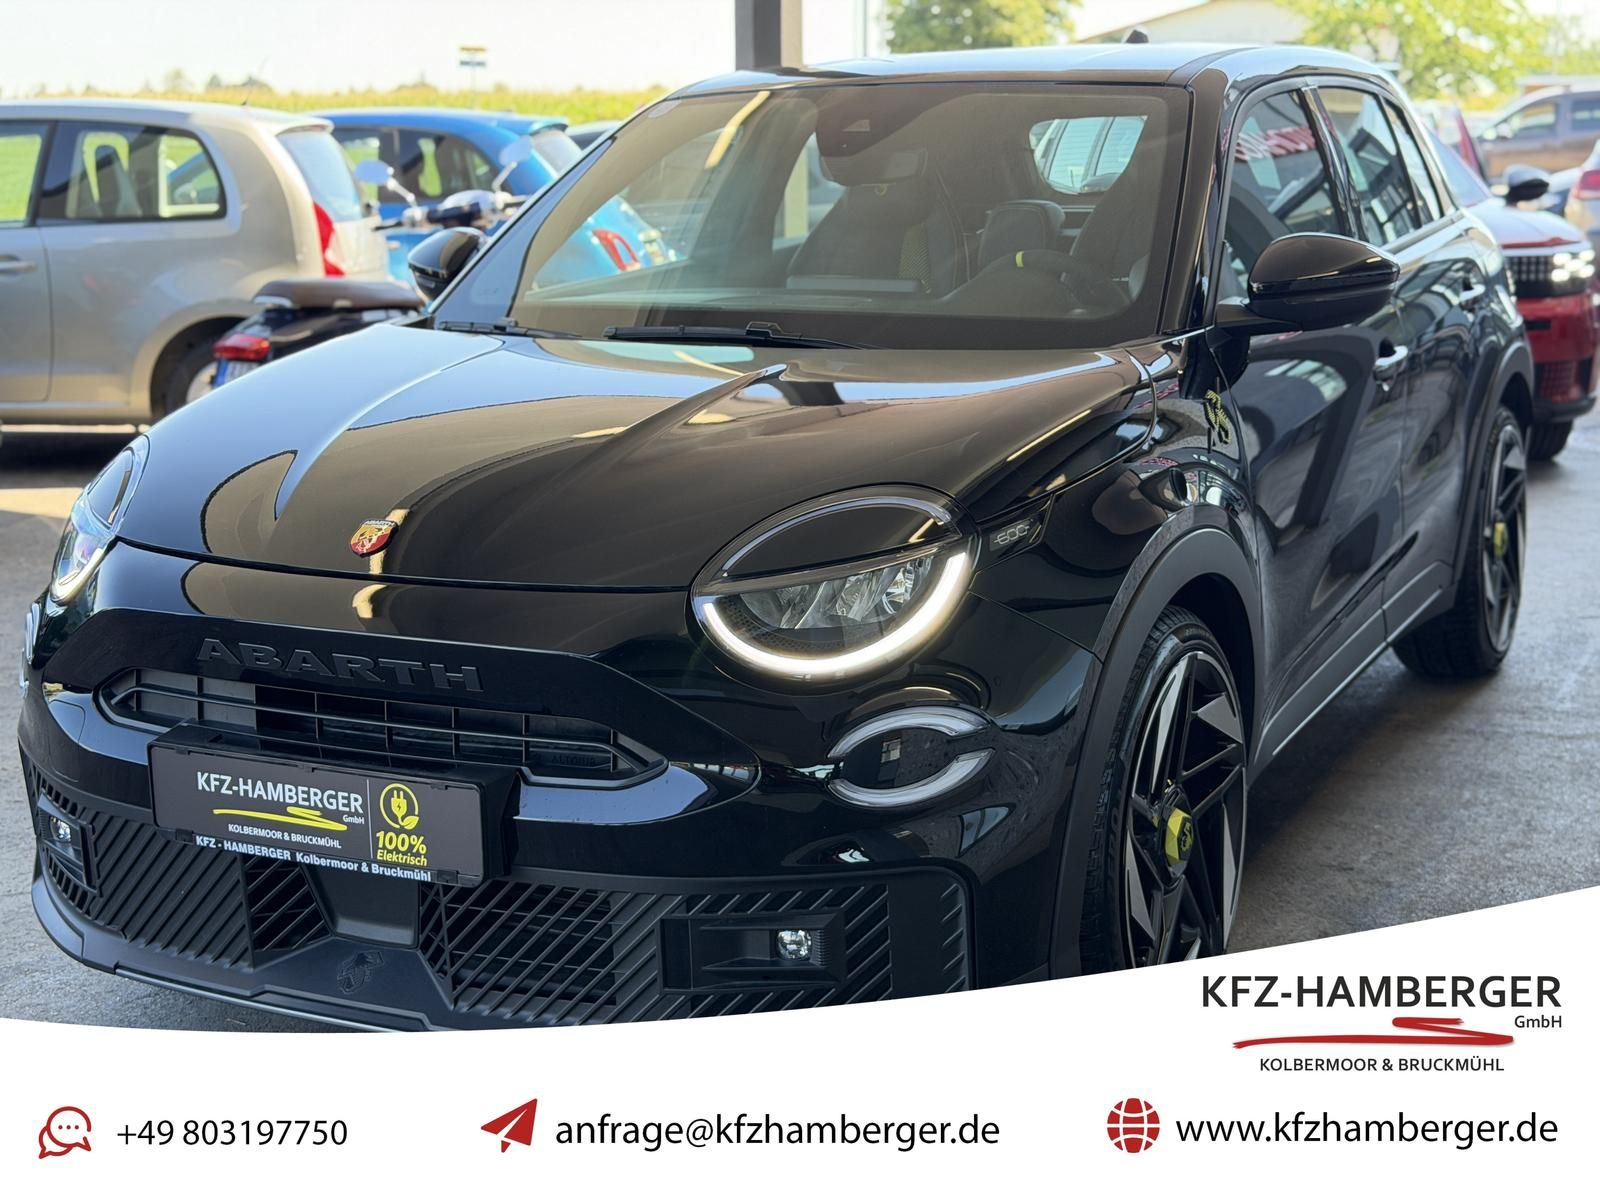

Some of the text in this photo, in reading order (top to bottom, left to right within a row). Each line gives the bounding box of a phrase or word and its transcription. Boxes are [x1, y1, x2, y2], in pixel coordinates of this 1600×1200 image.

[197, 637, 485, 693] ABARTH
[196, 771, 364, 814] KFZ-HAMBERGER
[342, 813, 366, 825] GmbH
[228, 823, 343, 849] KOLBERMOOR & BRUCKMÜHL
[375, 830, 428, 855] 100%
[195, 835, 217, 850] KFZ
[223, 839, 292, 861] HAMBERGER
[295, 852, 360, 873] Kolbermoor
[360, 861, 370, 874] &
[371, 864, 432, 882] Bruckmühl
[376, 849, 429, 867] Elektrisch
